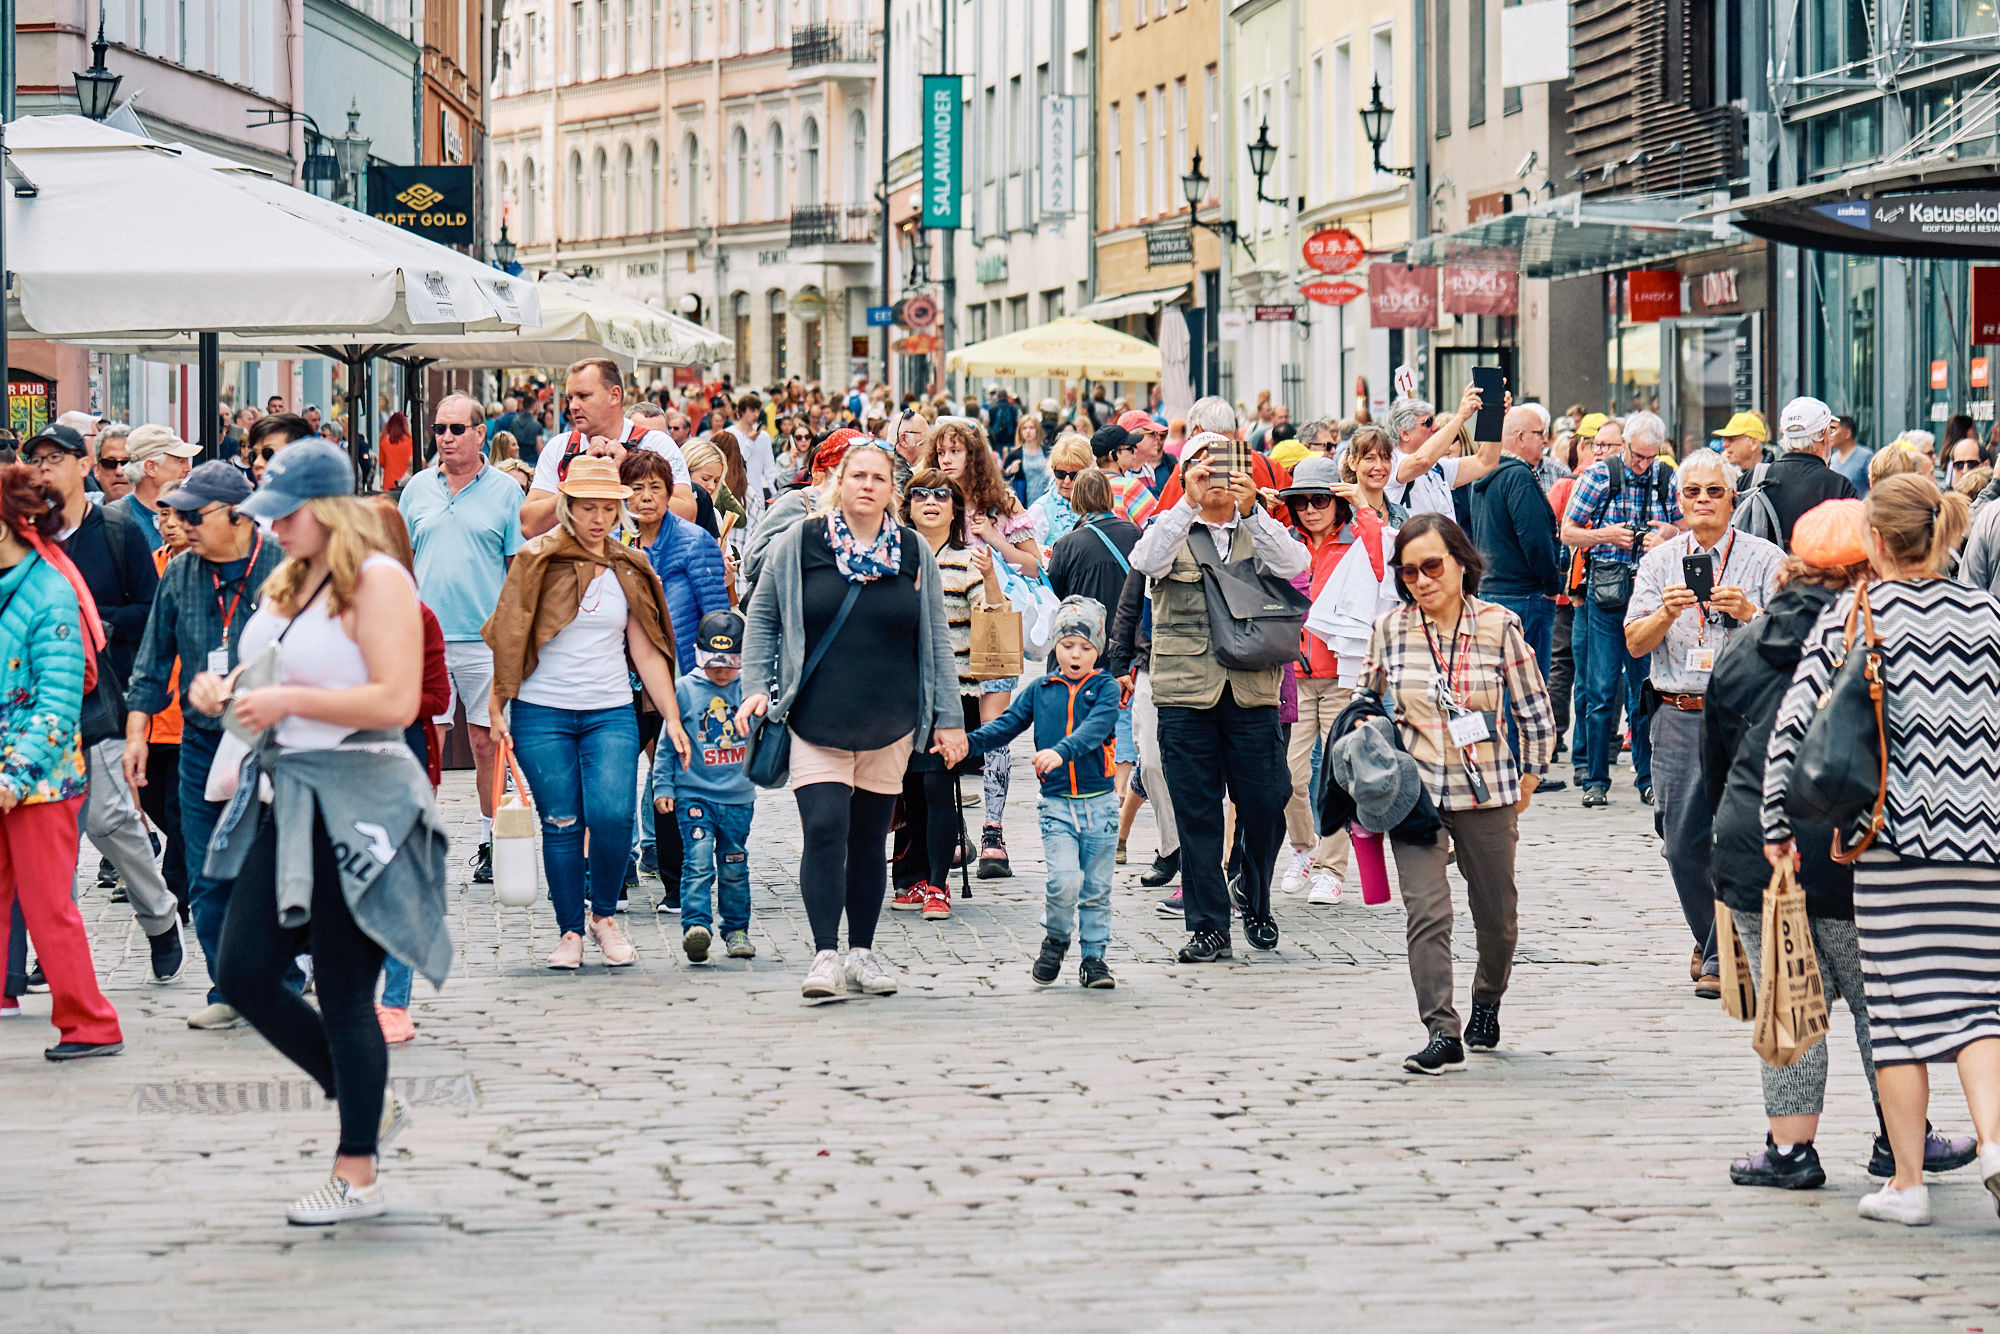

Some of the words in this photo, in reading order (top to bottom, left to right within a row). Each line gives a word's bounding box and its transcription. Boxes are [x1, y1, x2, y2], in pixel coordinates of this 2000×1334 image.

[933, 90, 951, 216] SALAMANDER
[420, 213, 467, 226] GOLD
[1922, 225, 1954, 233] ROOFTOP
[1635, 293, 1674, 302] LINDEX
[1983, 325, 2000, 335] R
[1398, 370, 1413, 392] 11
[20, 384, 44, 395] PUB
[704, 746, 746, 766] SAM
